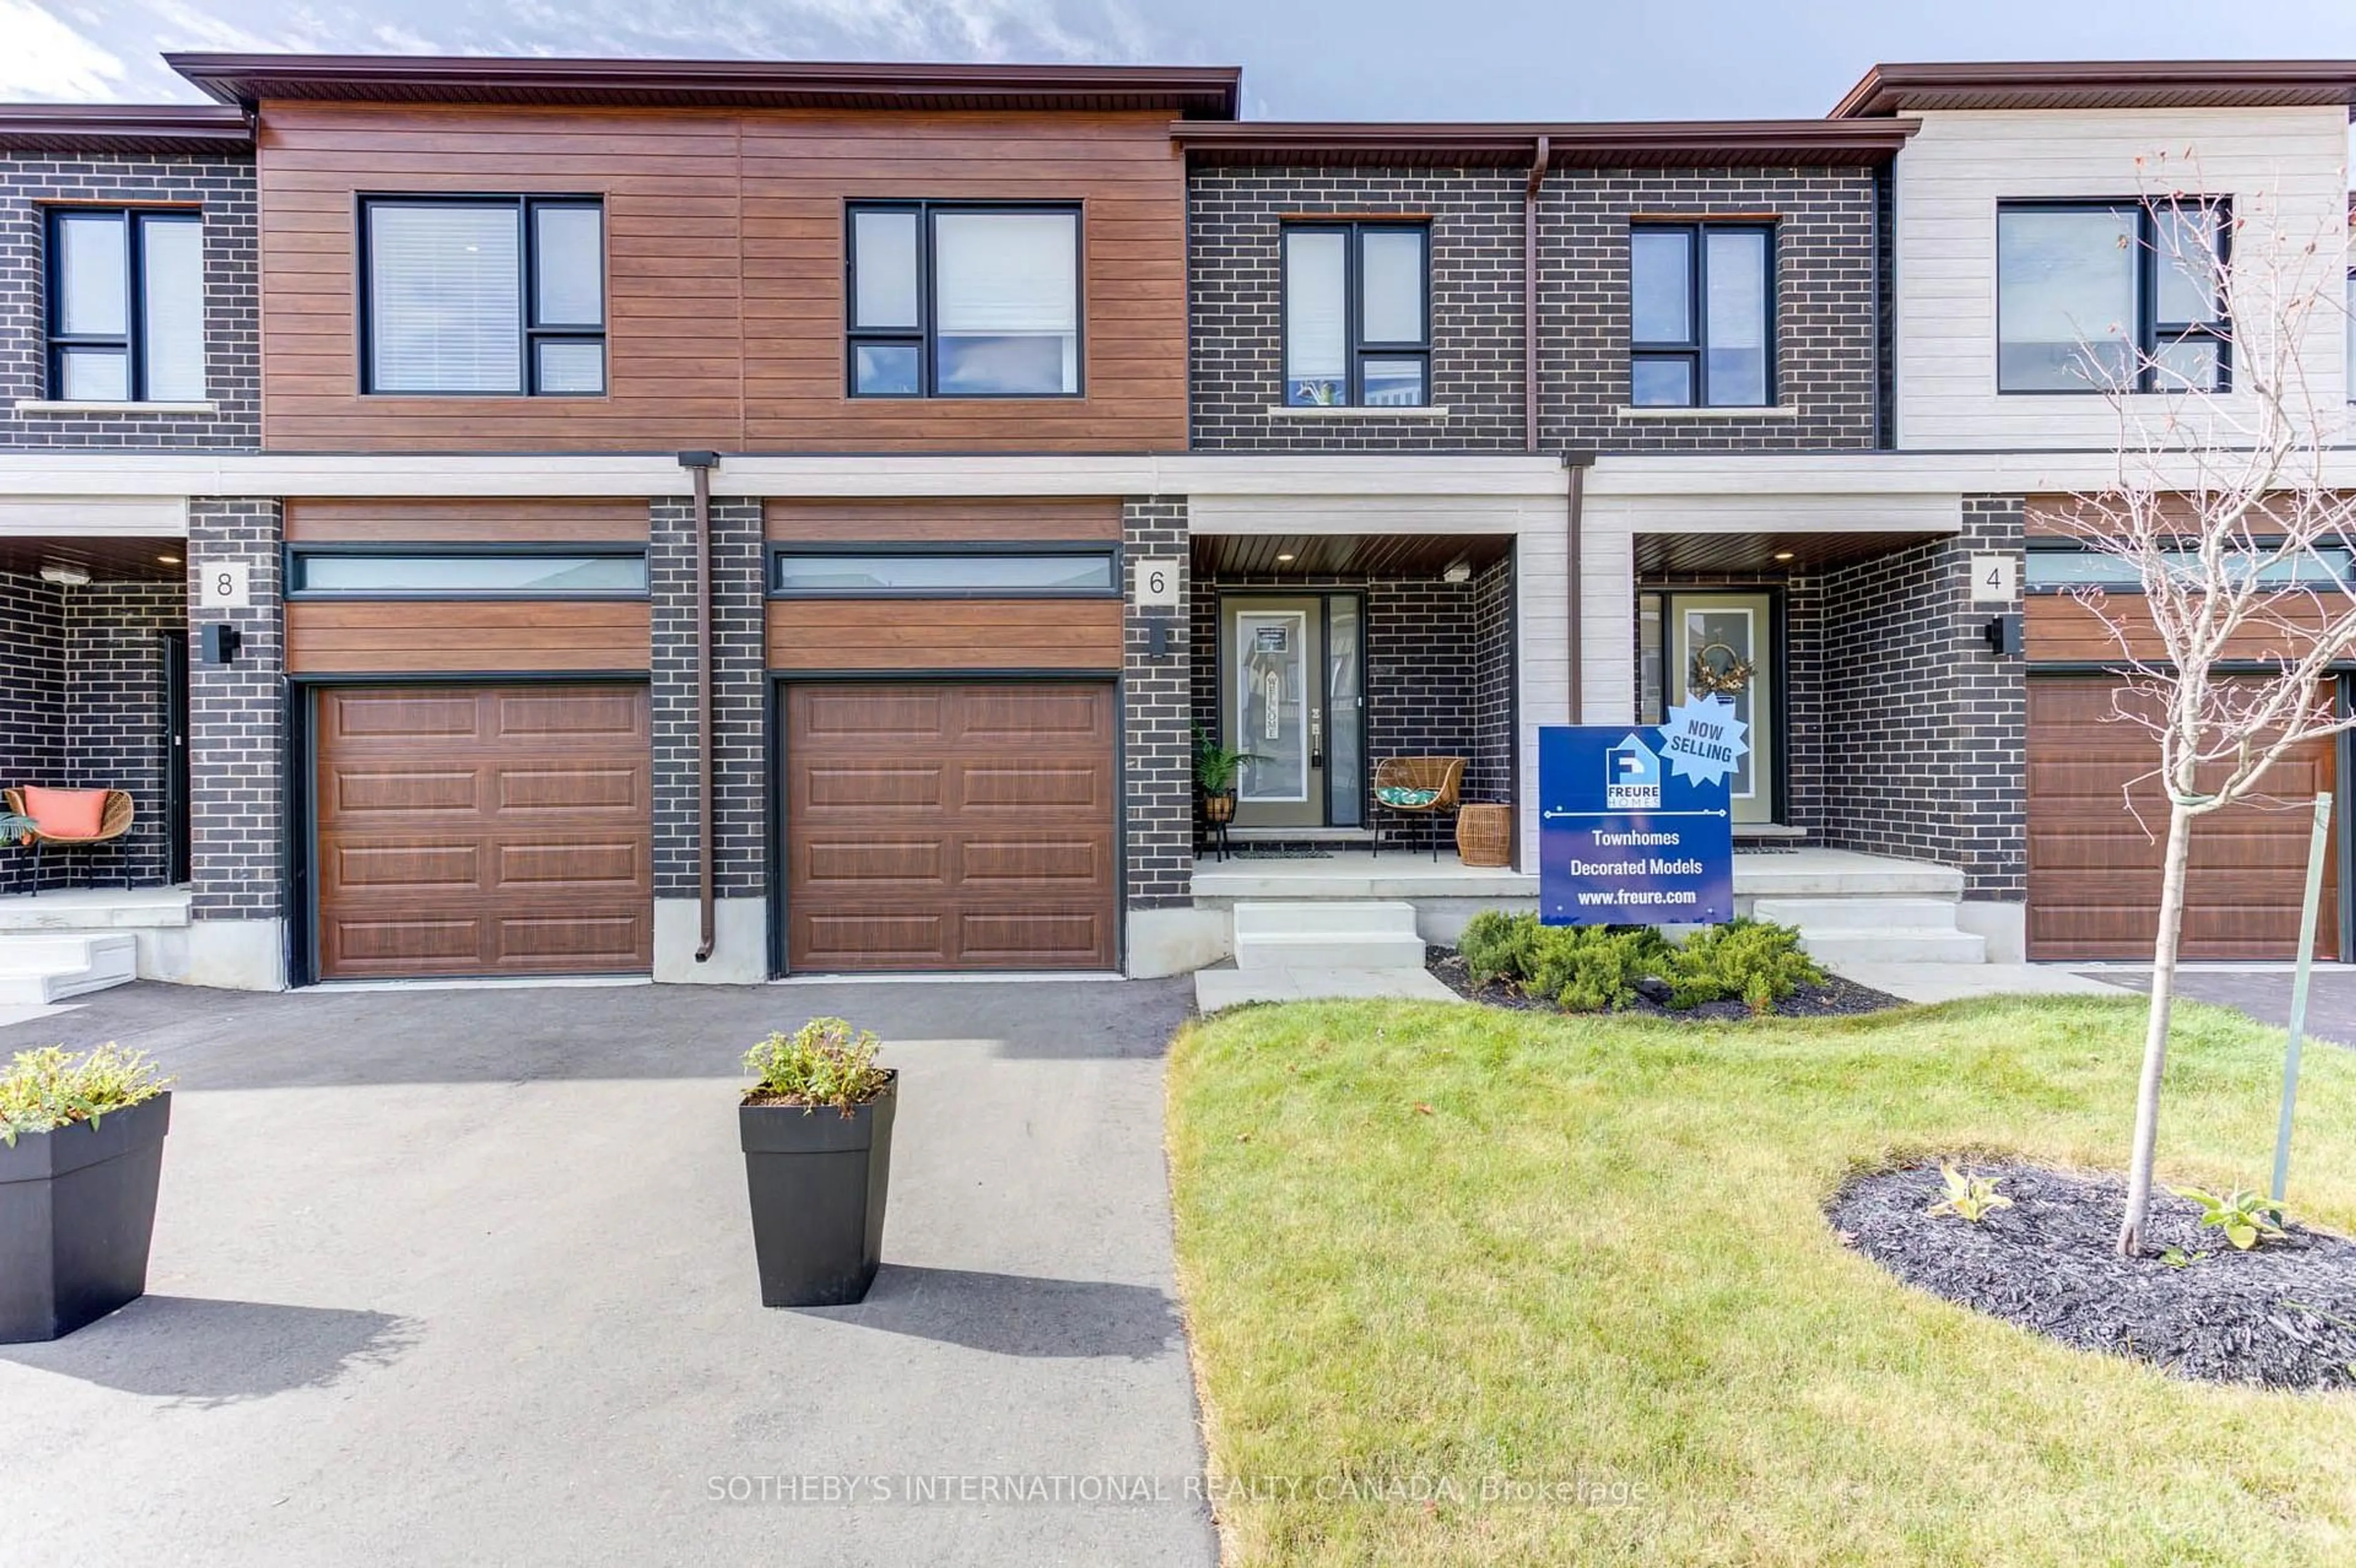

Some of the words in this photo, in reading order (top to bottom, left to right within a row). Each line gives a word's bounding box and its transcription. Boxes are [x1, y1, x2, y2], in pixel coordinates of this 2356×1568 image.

[217, 572, 233, 596] 8
[1150, 571, 1165, 593] 6
[1987, 568, 2001, 590] 4
[1688, 720, 1724, 741] NOW
[1671, 736, 1732, 763] SELLING
[1608, 786, 1659, 797] FREURE
[1608, 797, 1659, 807] HOMES
[1592, 829, 1680, 846] Townhomes
[1571, 859, 1646, 876] Decorated
[1650, 858, 1703, 875] Models
[1578, 888, 1696, 905] www.freure.com
